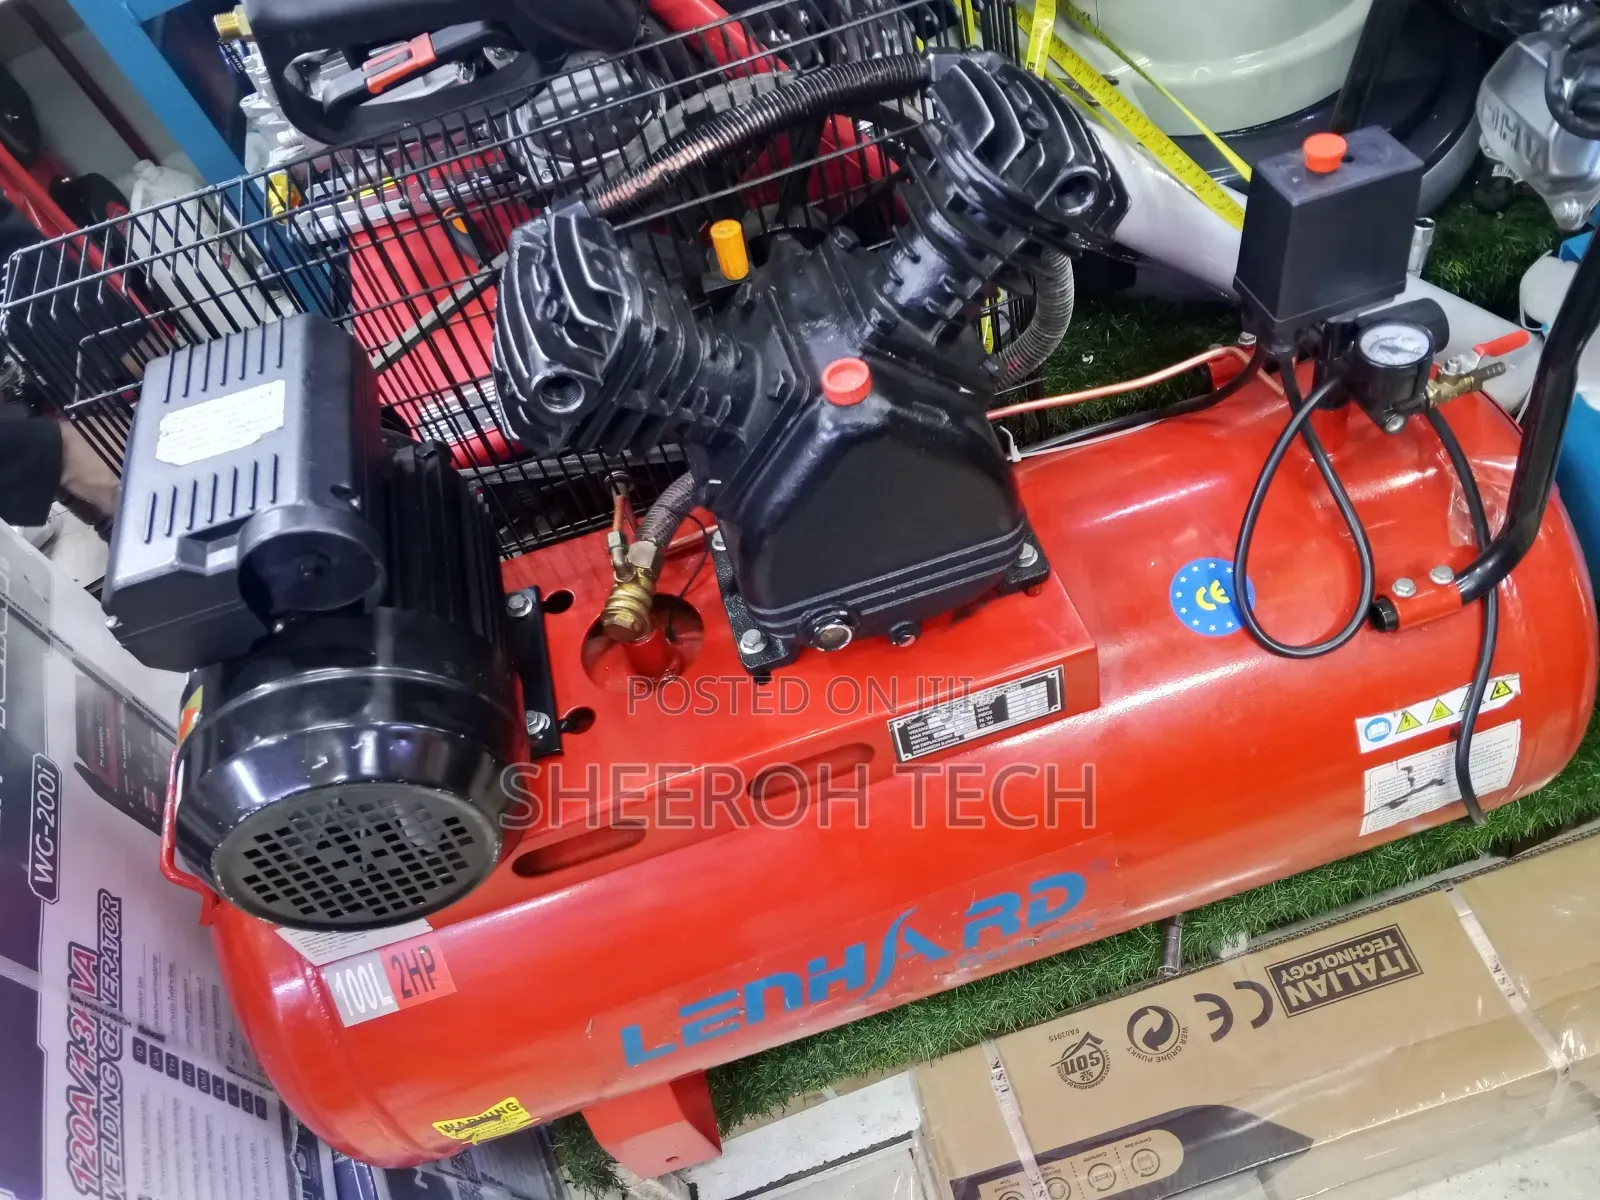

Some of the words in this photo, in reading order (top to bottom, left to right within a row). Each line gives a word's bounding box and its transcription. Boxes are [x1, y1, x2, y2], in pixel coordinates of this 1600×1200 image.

[976, 705, 990, 713] TANK
[907, 720, 925, 730] MODEL
[909, 732, 922, 741] MAX
[920, 732, 955, 748] DISPLACEMENT
[913, 741, 941, 755] DIMENSION
[34, 764, 55, 883] WG-200i
[1281, 934, 1397, 983] TECHNOLOGY
[335, 962, 393, 1016] 100L
[390, 945, 435, 999] 2HP
[1283, 948, 1409, 1006] ITALIAN
[1048, 1027, 1079, 1042] FA03915
[1178, 1026, 1188, 1044] WER
[1126, 1046, 1152, 1062] PUNKT
[1155, 1045, 1181, 1062] GRÜNE
